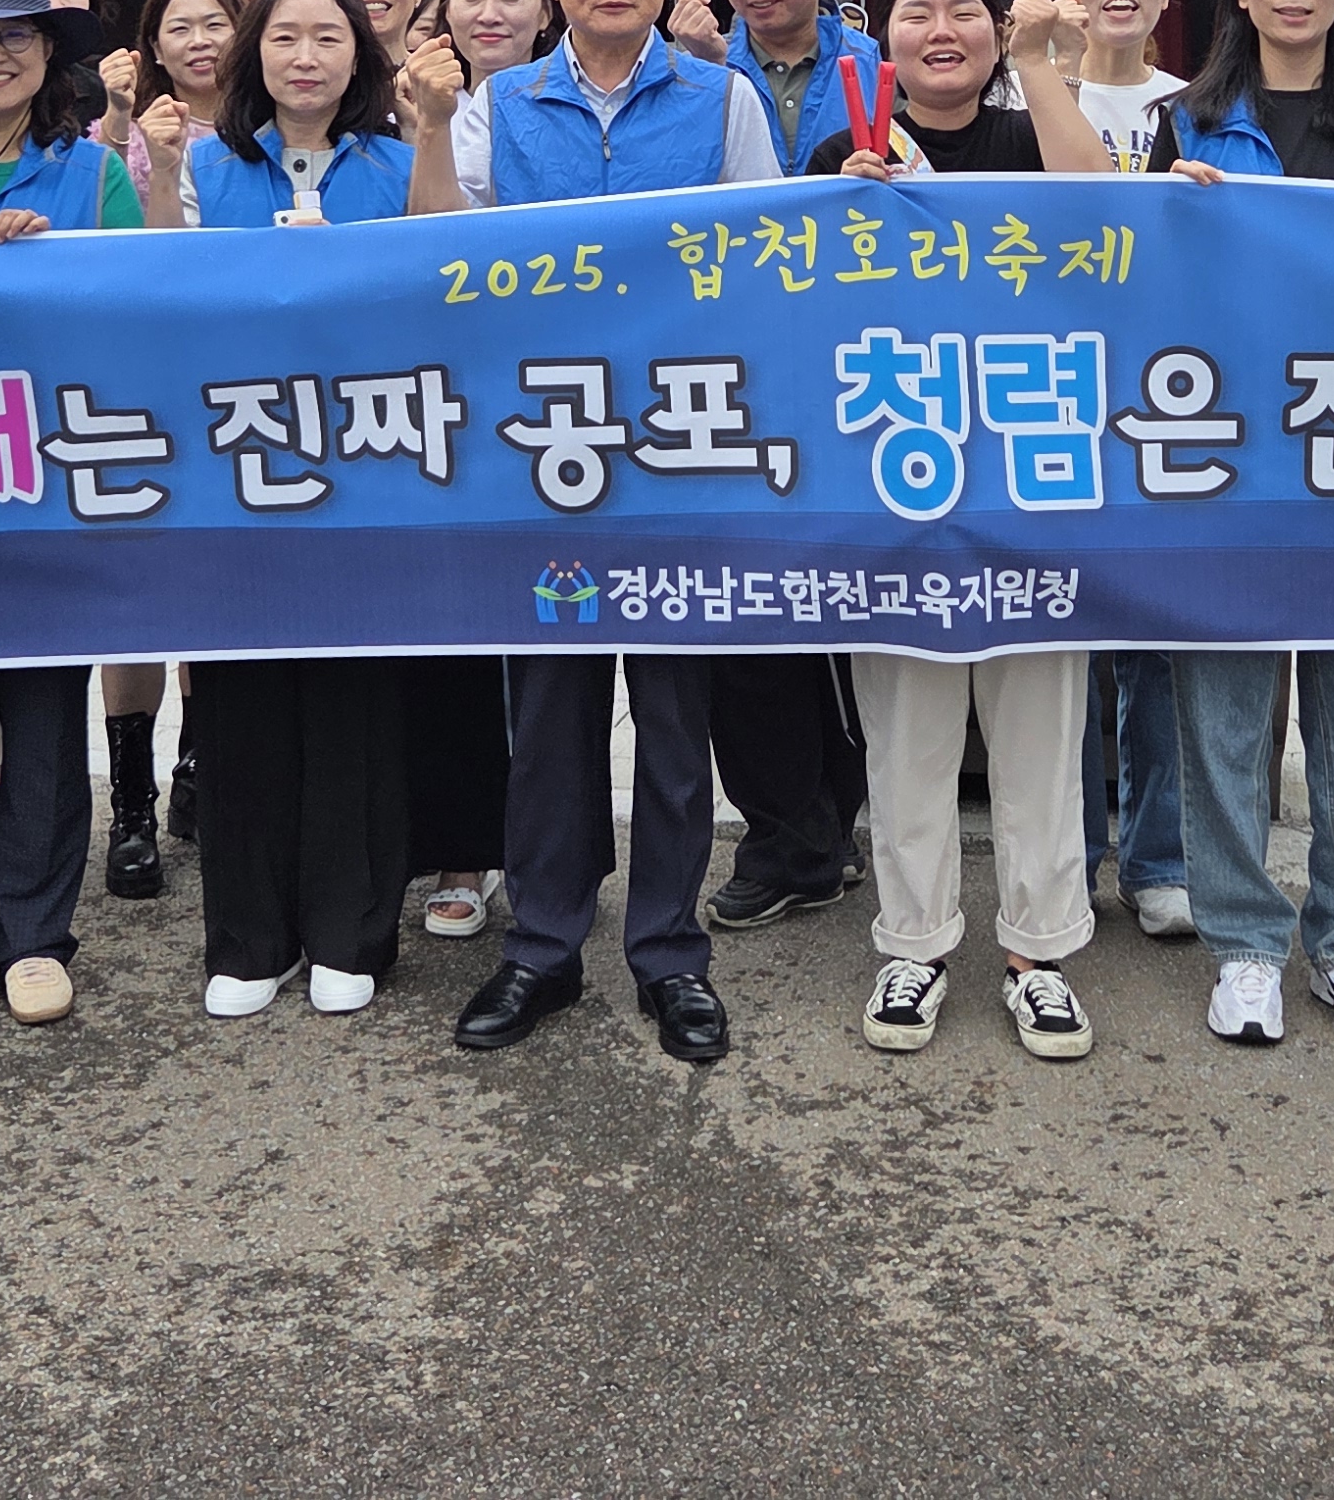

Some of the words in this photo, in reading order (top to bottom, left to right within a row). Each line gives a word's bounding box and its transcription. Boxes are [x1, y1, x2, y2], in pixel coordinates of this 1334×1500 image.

[438, 244, 629, 304] 2025.
[666, 207, 1136, 301] 합천호러축제
[203, 365, 470, 512] 진짜
[497, 358, 797, 512] 공포,
[835, 327, 1245, 520] 청렴은
[606, 564, 1080, 629] 경상남도합천교육지원청
